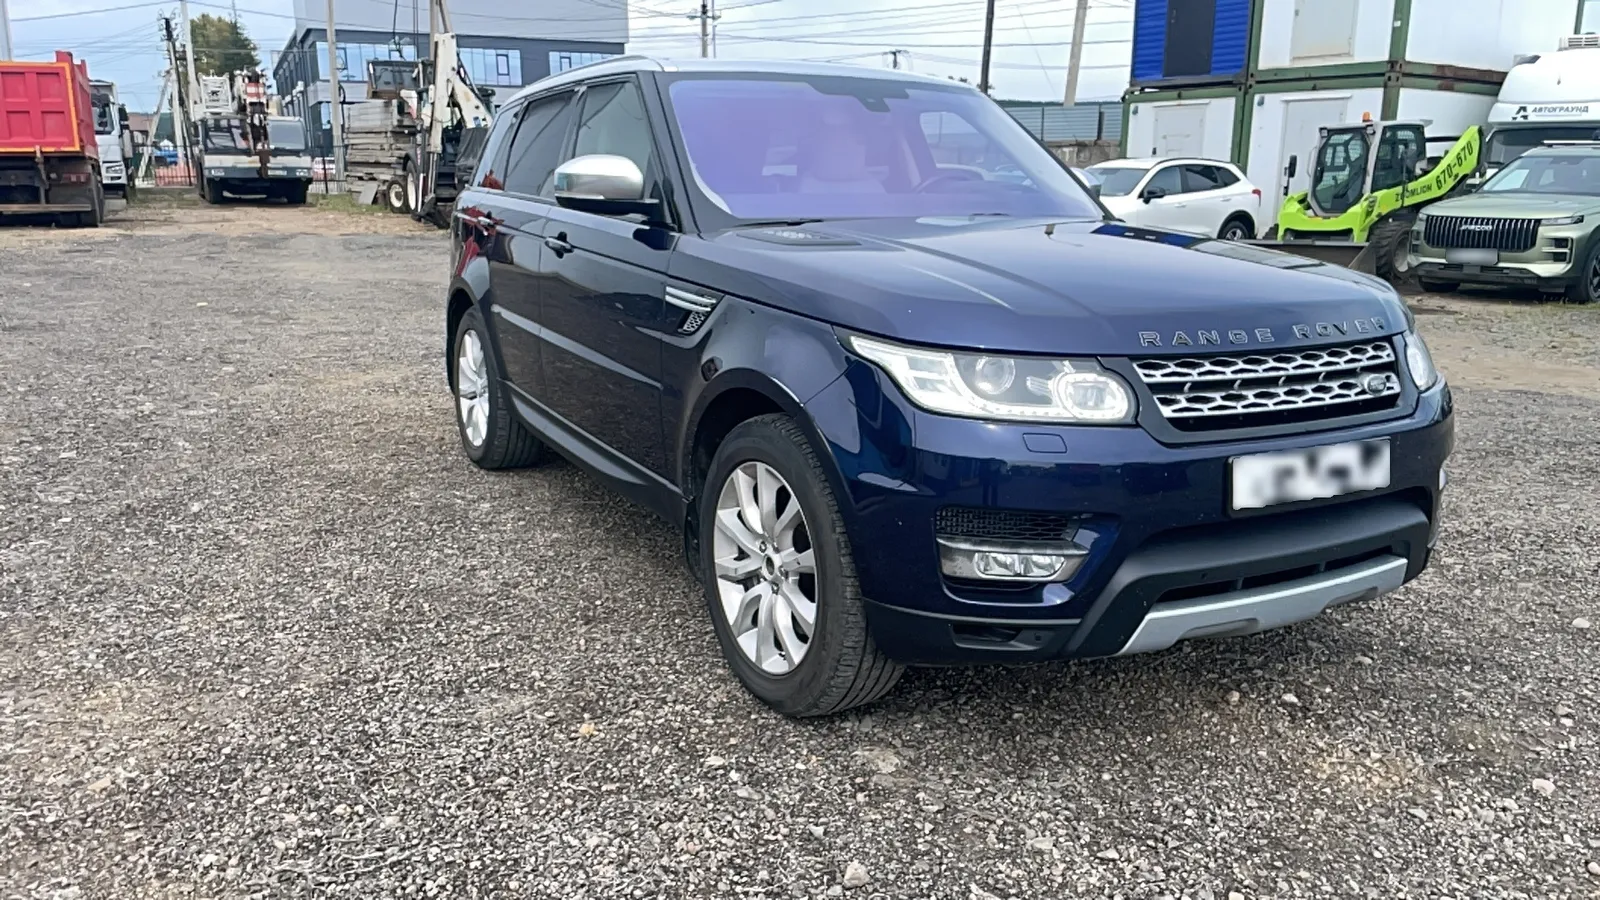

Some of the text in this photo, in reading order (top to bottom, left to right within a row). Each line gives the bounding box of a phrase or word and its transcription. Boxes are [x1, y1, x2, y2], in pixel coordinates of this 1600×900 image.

[1531, 105, 1589, 113] АВТОГРАУНД
[1435, 140, 1474, 190] 670-670
[1138, 317, 1386, 347] RANGE ROVER
